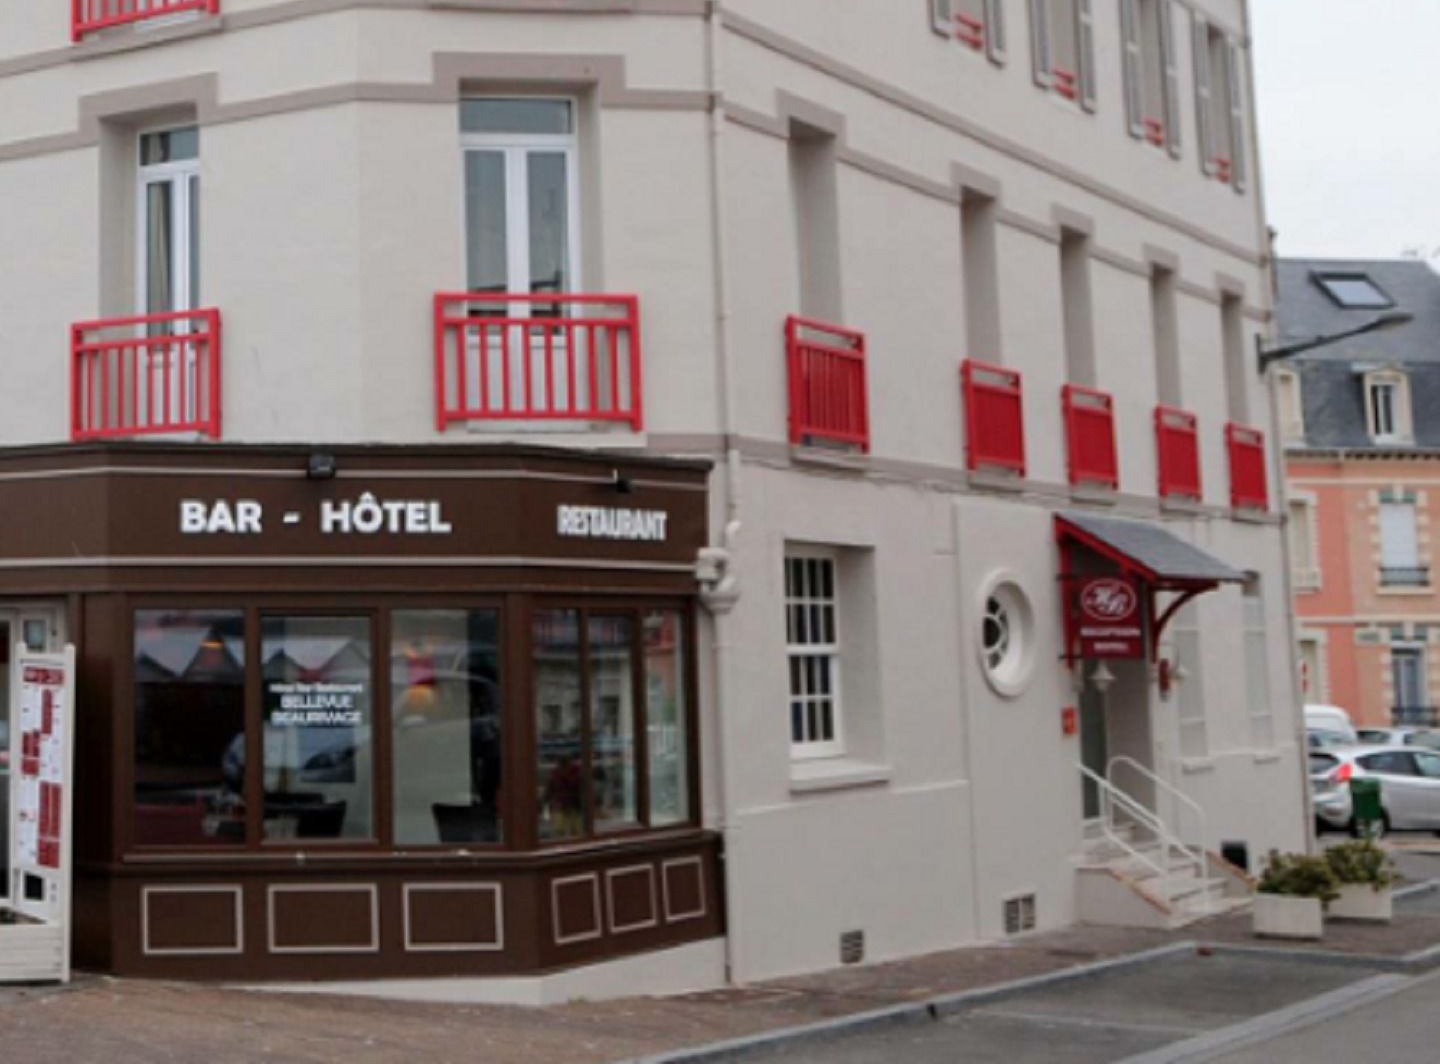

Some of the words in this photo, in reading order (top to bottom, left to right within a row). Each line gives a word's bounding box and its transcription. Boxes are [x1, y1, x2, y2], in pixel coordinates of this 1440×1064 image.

[180, 500, 262, 533] BAR
[320, 490, 452, 533] HÔTEL
[556, 504, 667, 541] RESTAURANT
[280, 693, 354, 708] BELLEVUE
